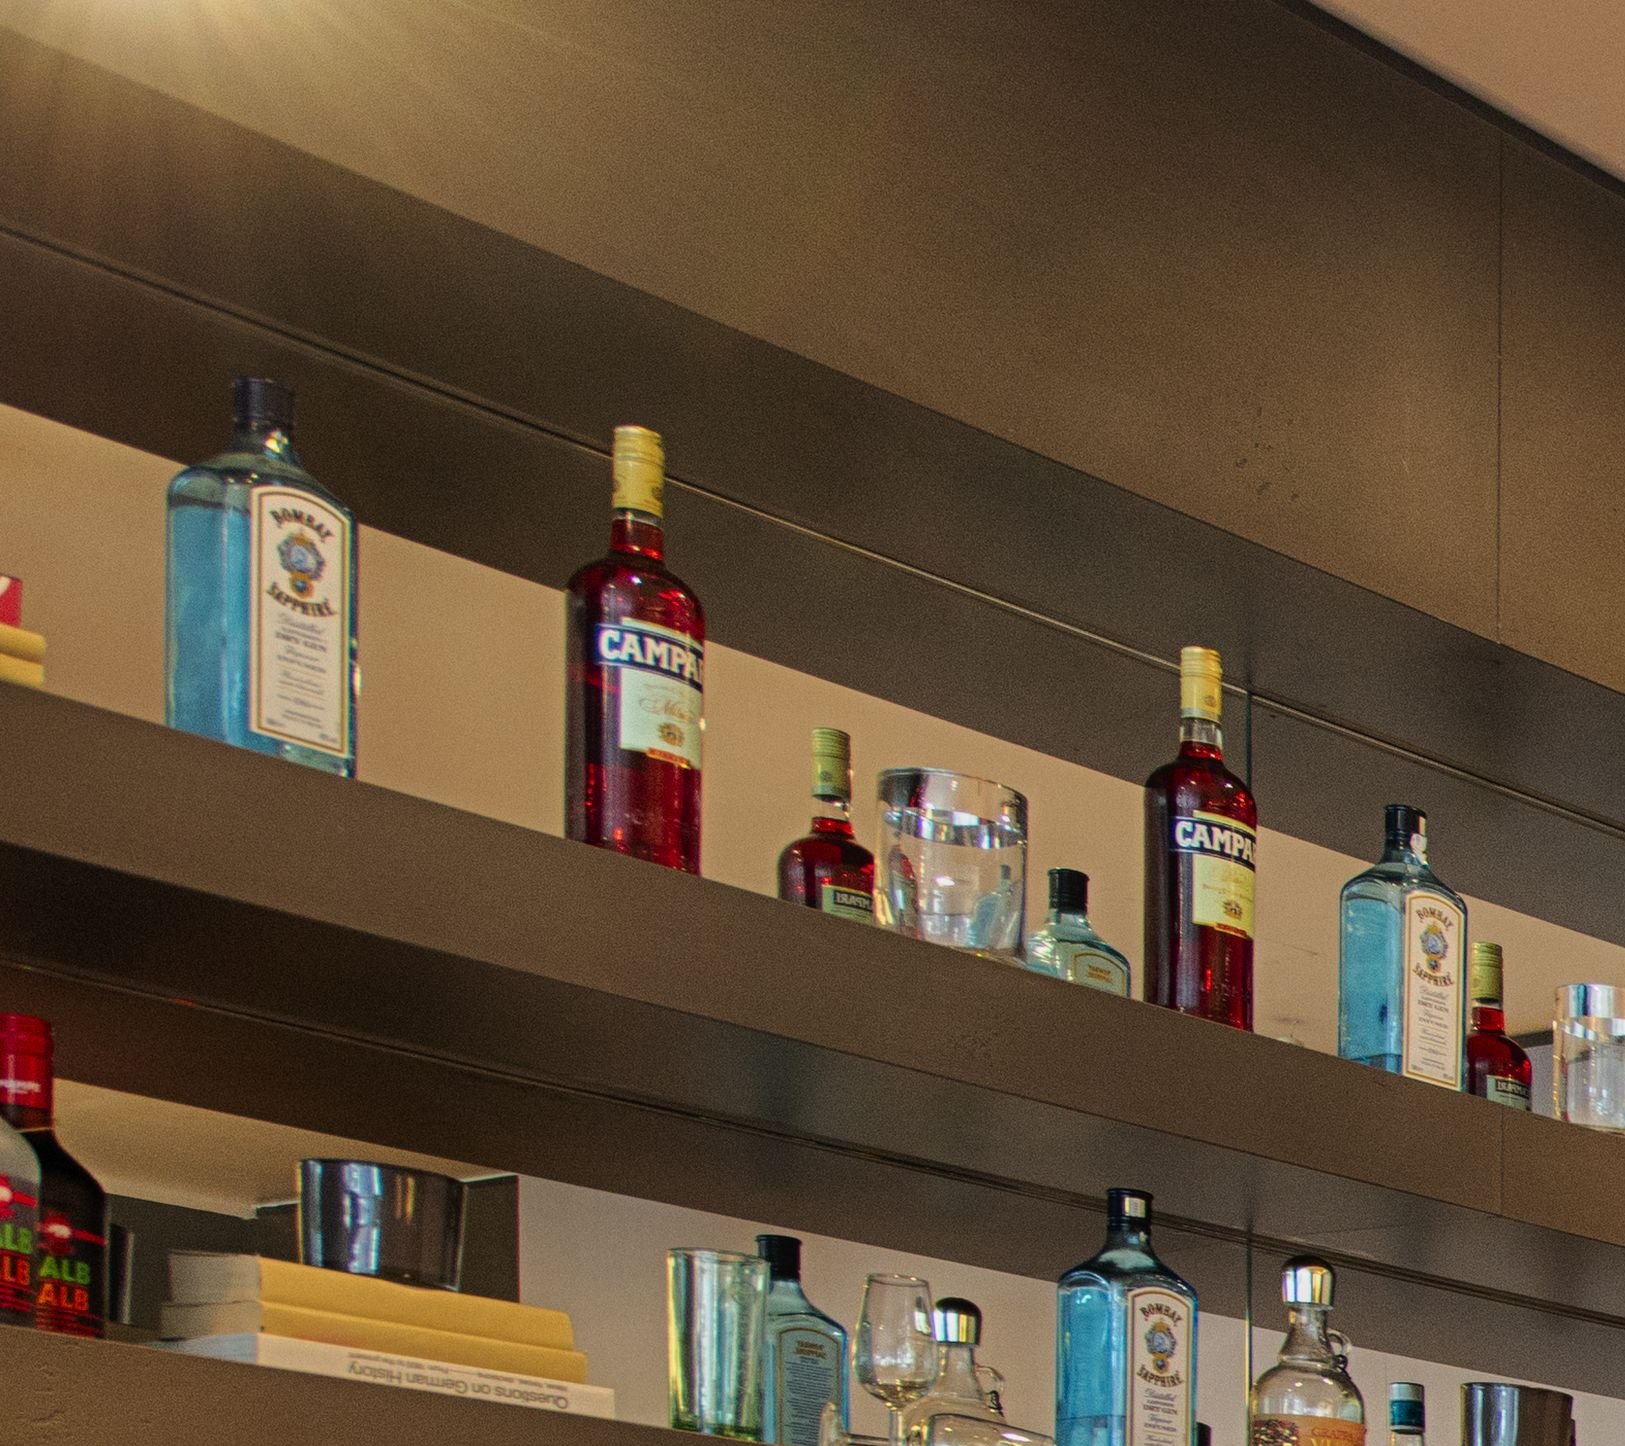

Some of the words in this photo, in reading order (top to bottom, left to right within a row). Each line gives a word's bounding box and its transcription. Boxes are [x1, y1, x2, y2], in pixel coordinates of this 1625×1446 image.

[270, 507, 334, 543] BOMBAY
[266, 582, 337, 617] SAPPHIRE
[600, 629, 702, 681] CAMPA
[1175, 820, 1256, 862] CAMPA
[1416, 906, 1454, 931] BOMBAY
[1412, 963, 1454, 987] SAPPHIRE
[0, 1223, 33, 1253] LB
[1139, 1302, 1183, 1327] BOMBAY
[348, 1361, 403, 1382] History
[405, 1373, 468, 1394] German
[1136, 1364, 1184, 1388] SAPPHIRE
[472, 1381, 491, 1395] on
[495, 1385, 569, 1410] Questions
